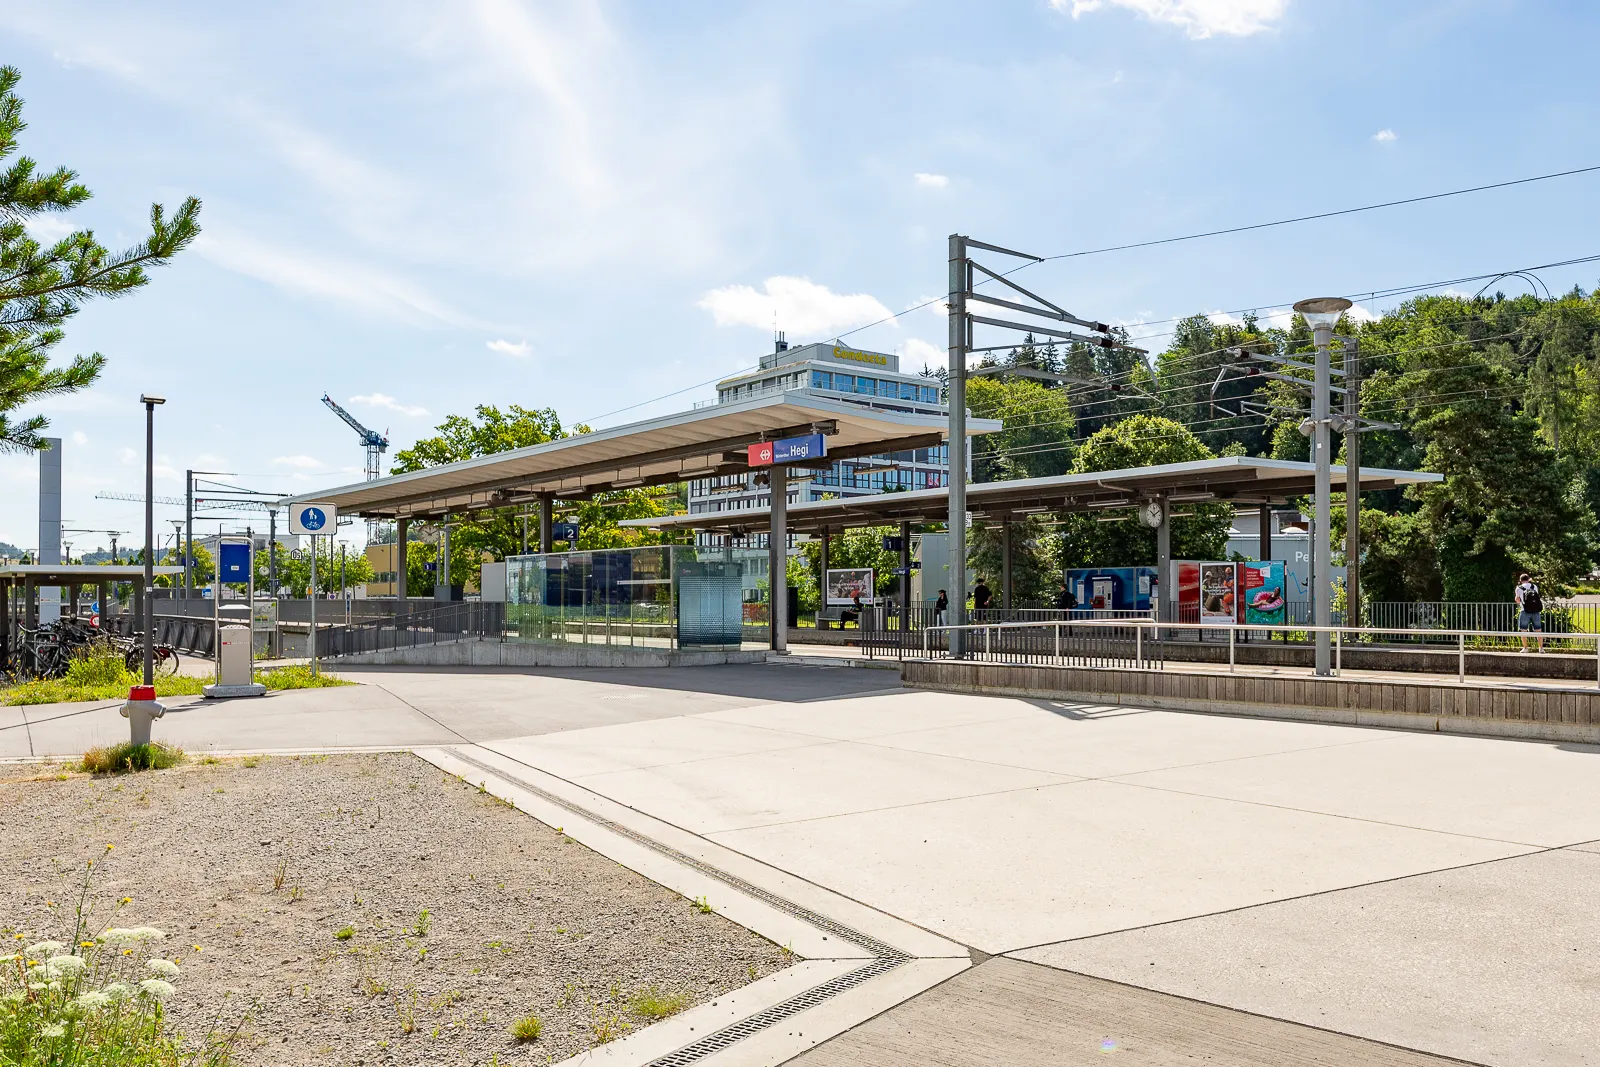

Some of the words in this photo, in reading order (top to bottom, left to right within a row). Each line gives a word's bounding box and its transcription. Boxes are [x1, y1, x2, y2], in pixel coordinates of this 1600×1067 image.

[833, 346, 887, 365] Condecta
[790, 443, 809, 457] Hegi
[567, 528, 575, 539] 2
